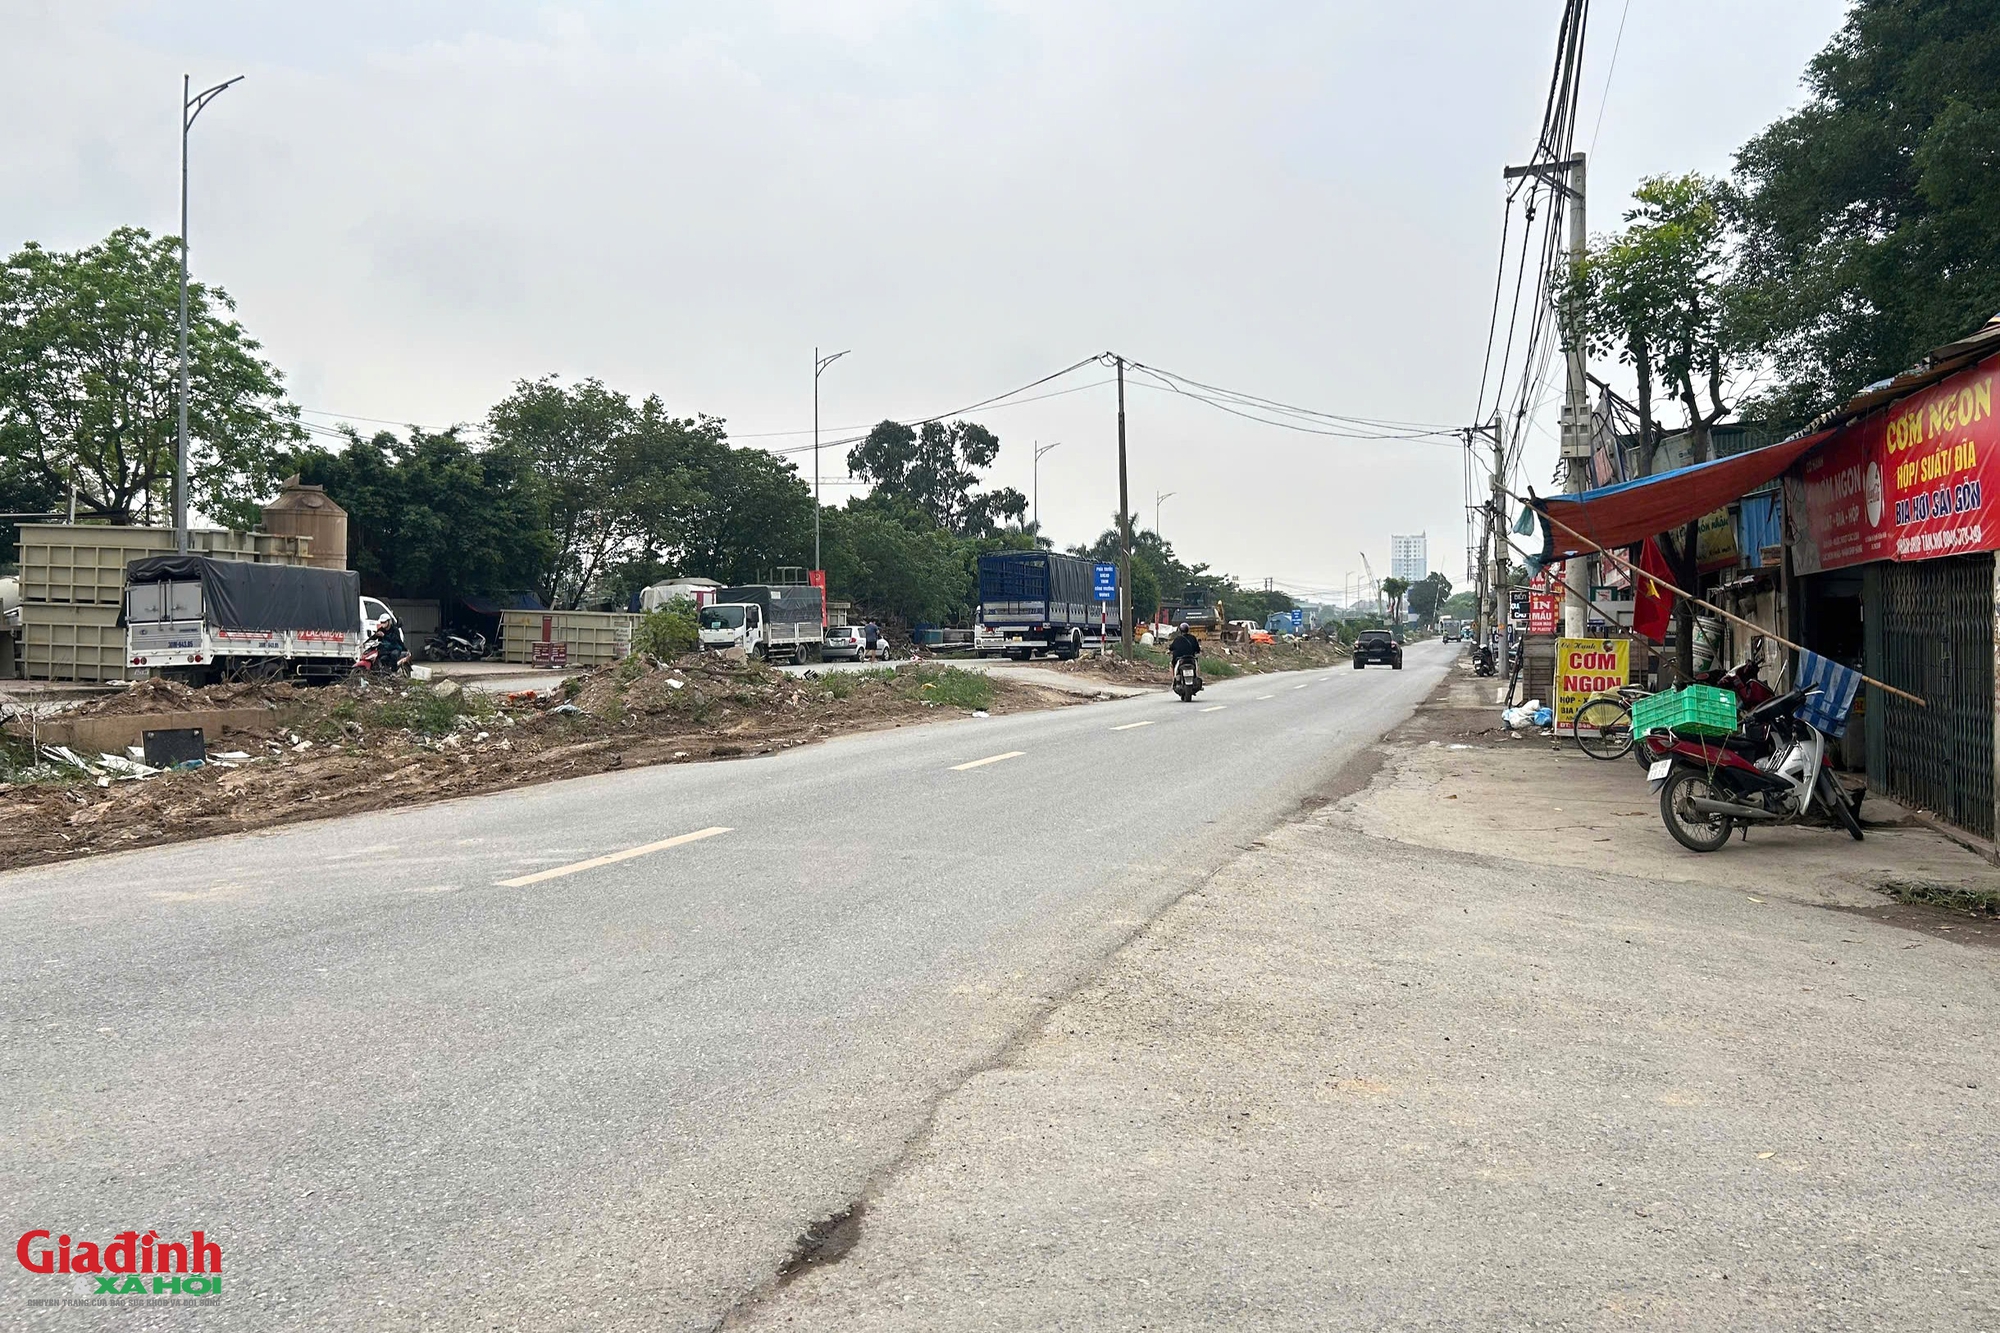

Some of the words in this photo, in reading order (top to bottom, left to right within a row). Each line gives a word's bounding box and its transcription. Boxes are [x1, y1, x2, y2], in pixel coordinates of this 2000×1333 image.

[1887, 408, 1923, 454] CƠM
[1928, 377, 1992, 440] NGON
[1954, 437, 1977, 472] ĐĨA
[1835, 464, 1861, 498] NGON
[1895, 499, 1911, 527] BIA
[1912, 491, 1930, 525] HƠI
[1569, 651, 1617, 671] CƠM
[1563, 675, 1622, 693] NGON
